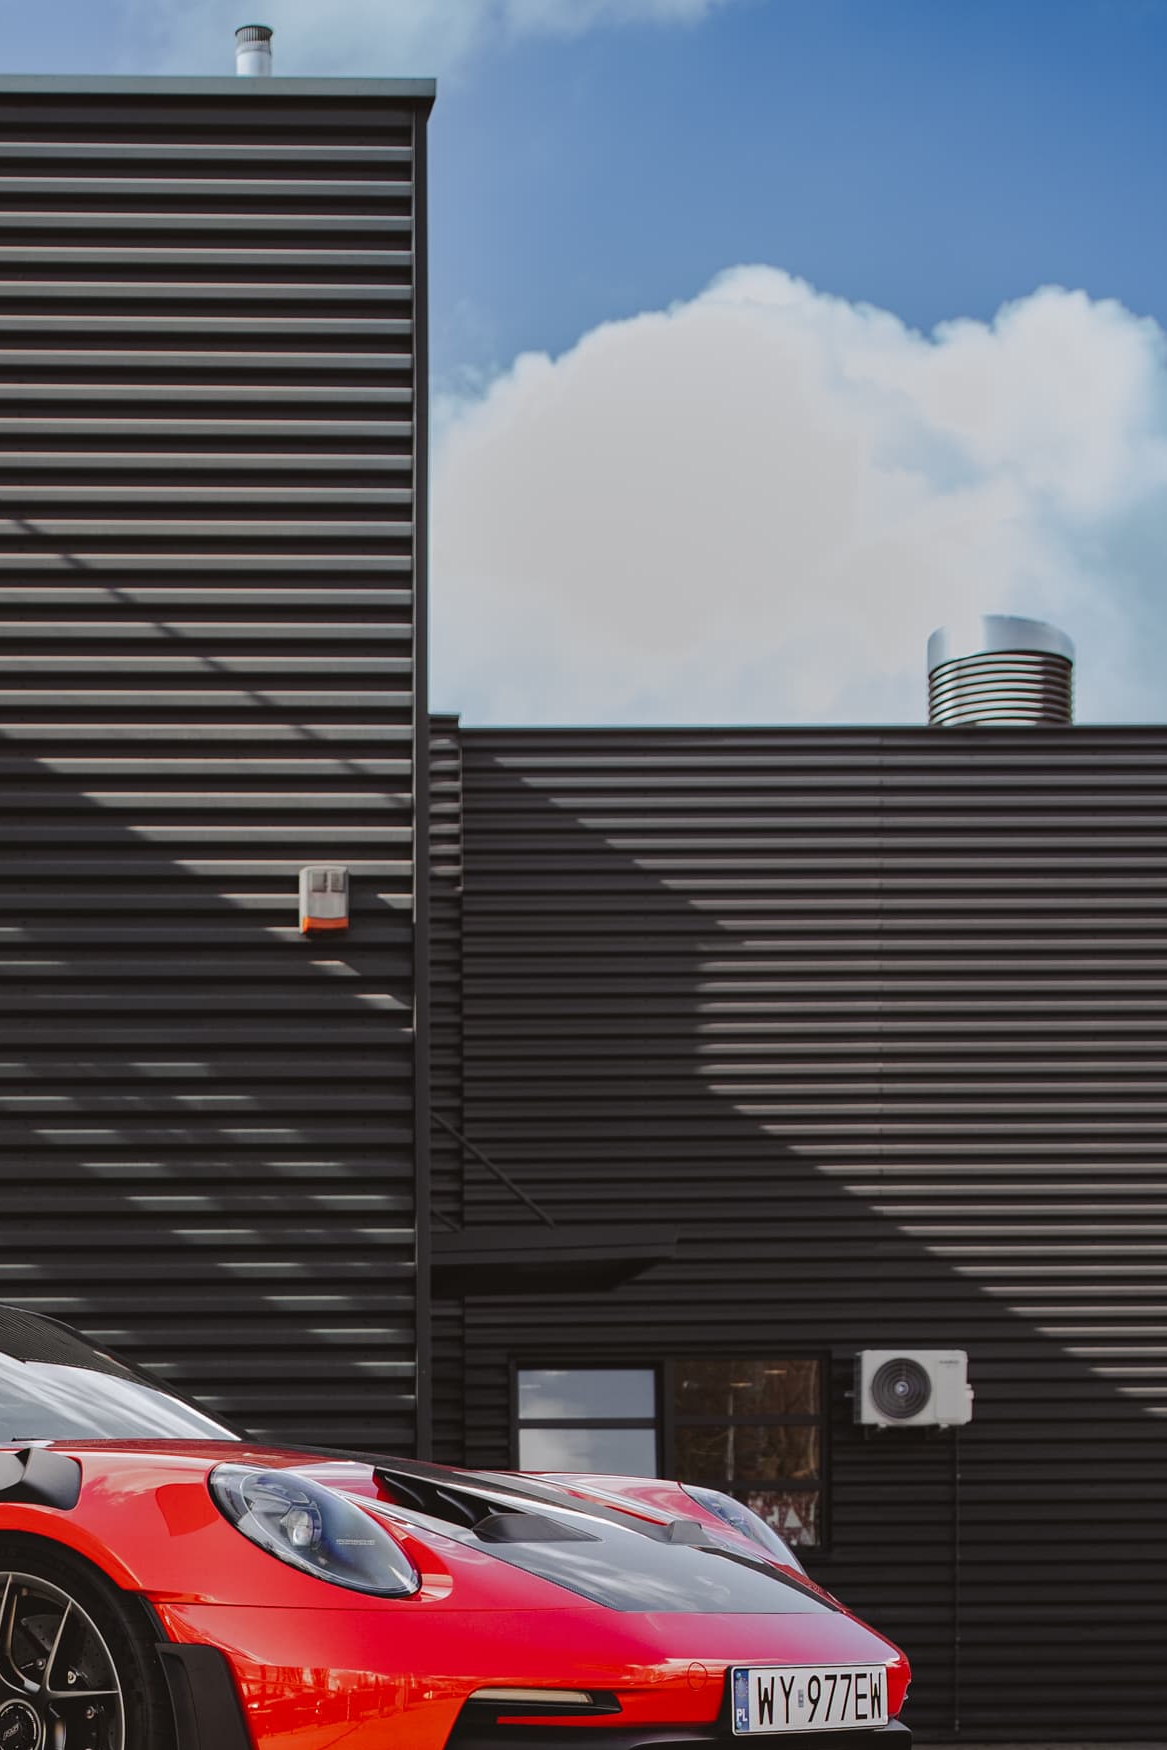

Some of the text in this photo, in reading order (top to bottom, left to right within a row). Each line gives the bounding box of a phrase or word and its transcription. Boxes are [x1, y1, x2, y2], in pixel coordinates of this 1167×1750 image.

[736, 1708, 748, 1721] PL
[757, 1672, 882, 1725] WY 977EW
